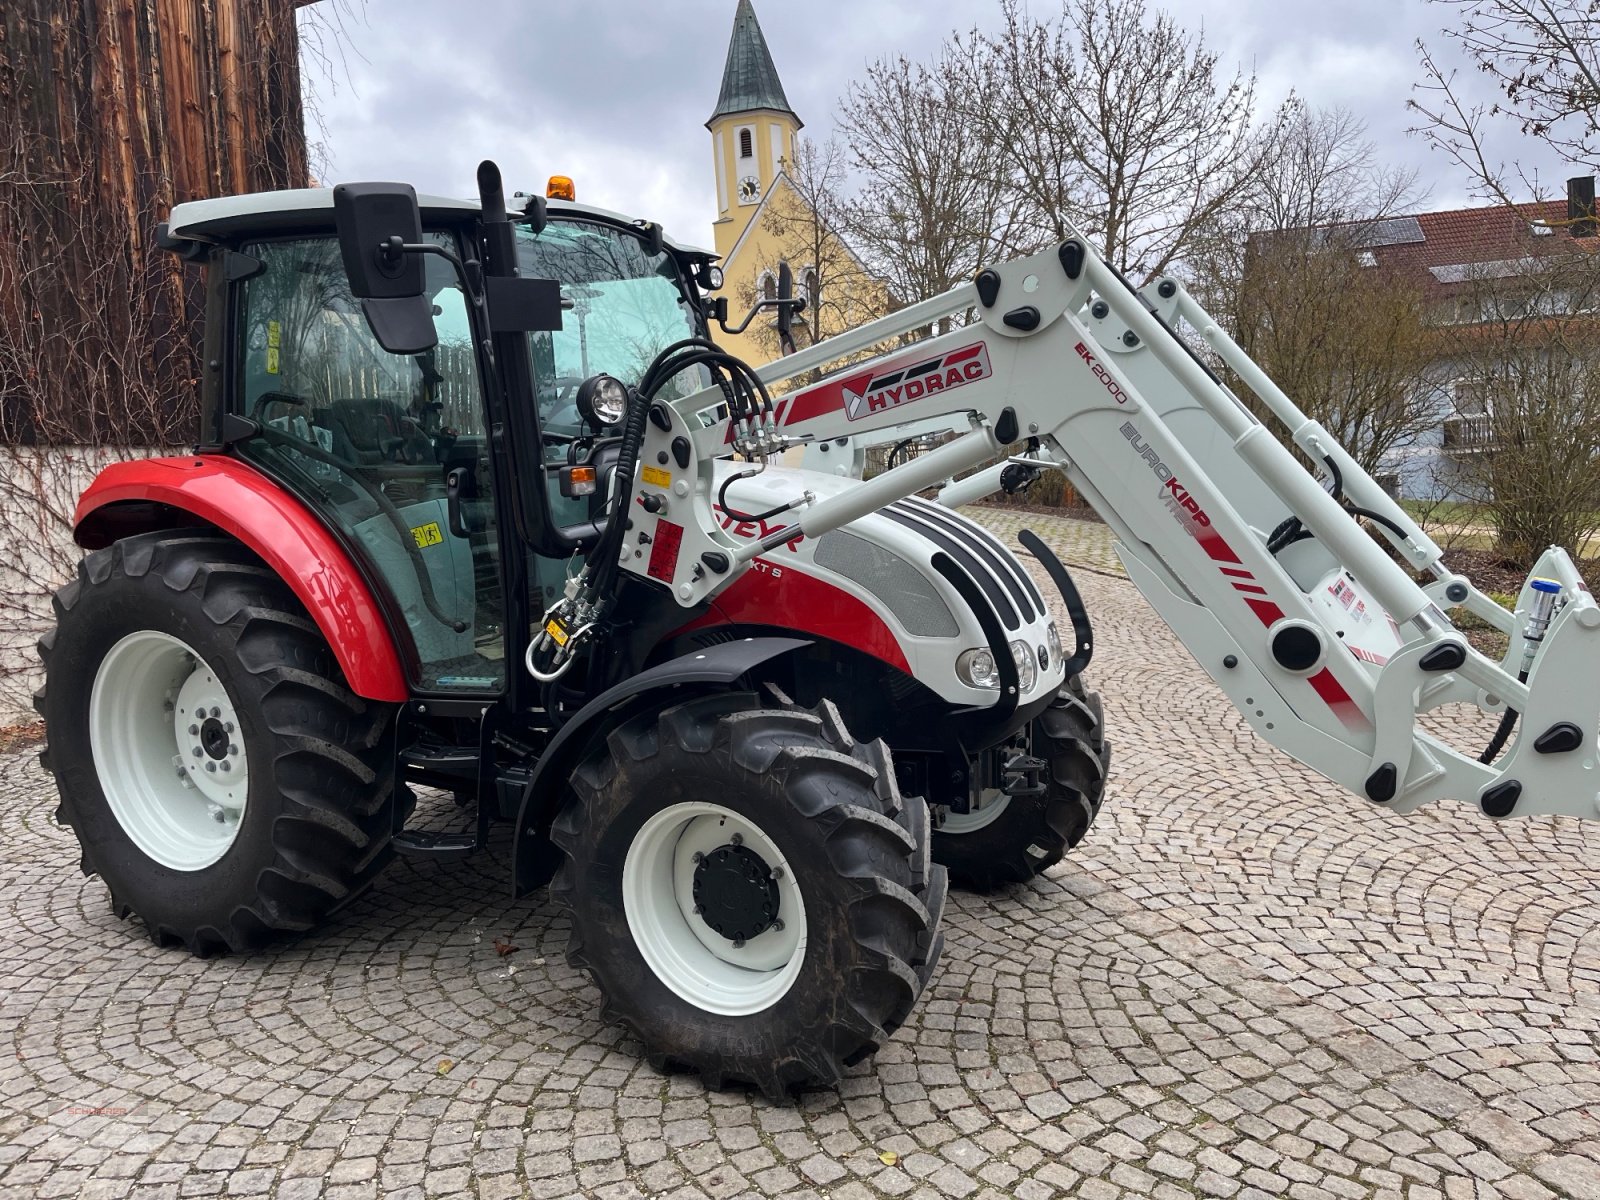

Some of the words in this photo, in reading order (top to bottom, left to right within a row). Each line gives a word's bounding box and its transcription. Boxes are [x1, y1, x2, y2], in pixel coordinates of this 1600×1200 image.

[867, 361, 983, 411] HYDRAC
[1074, 342, 1096, 366] EK
[1091, 364, 1127, 404] 2000
[1119, 421, 1211, 528] EUROKIPP
